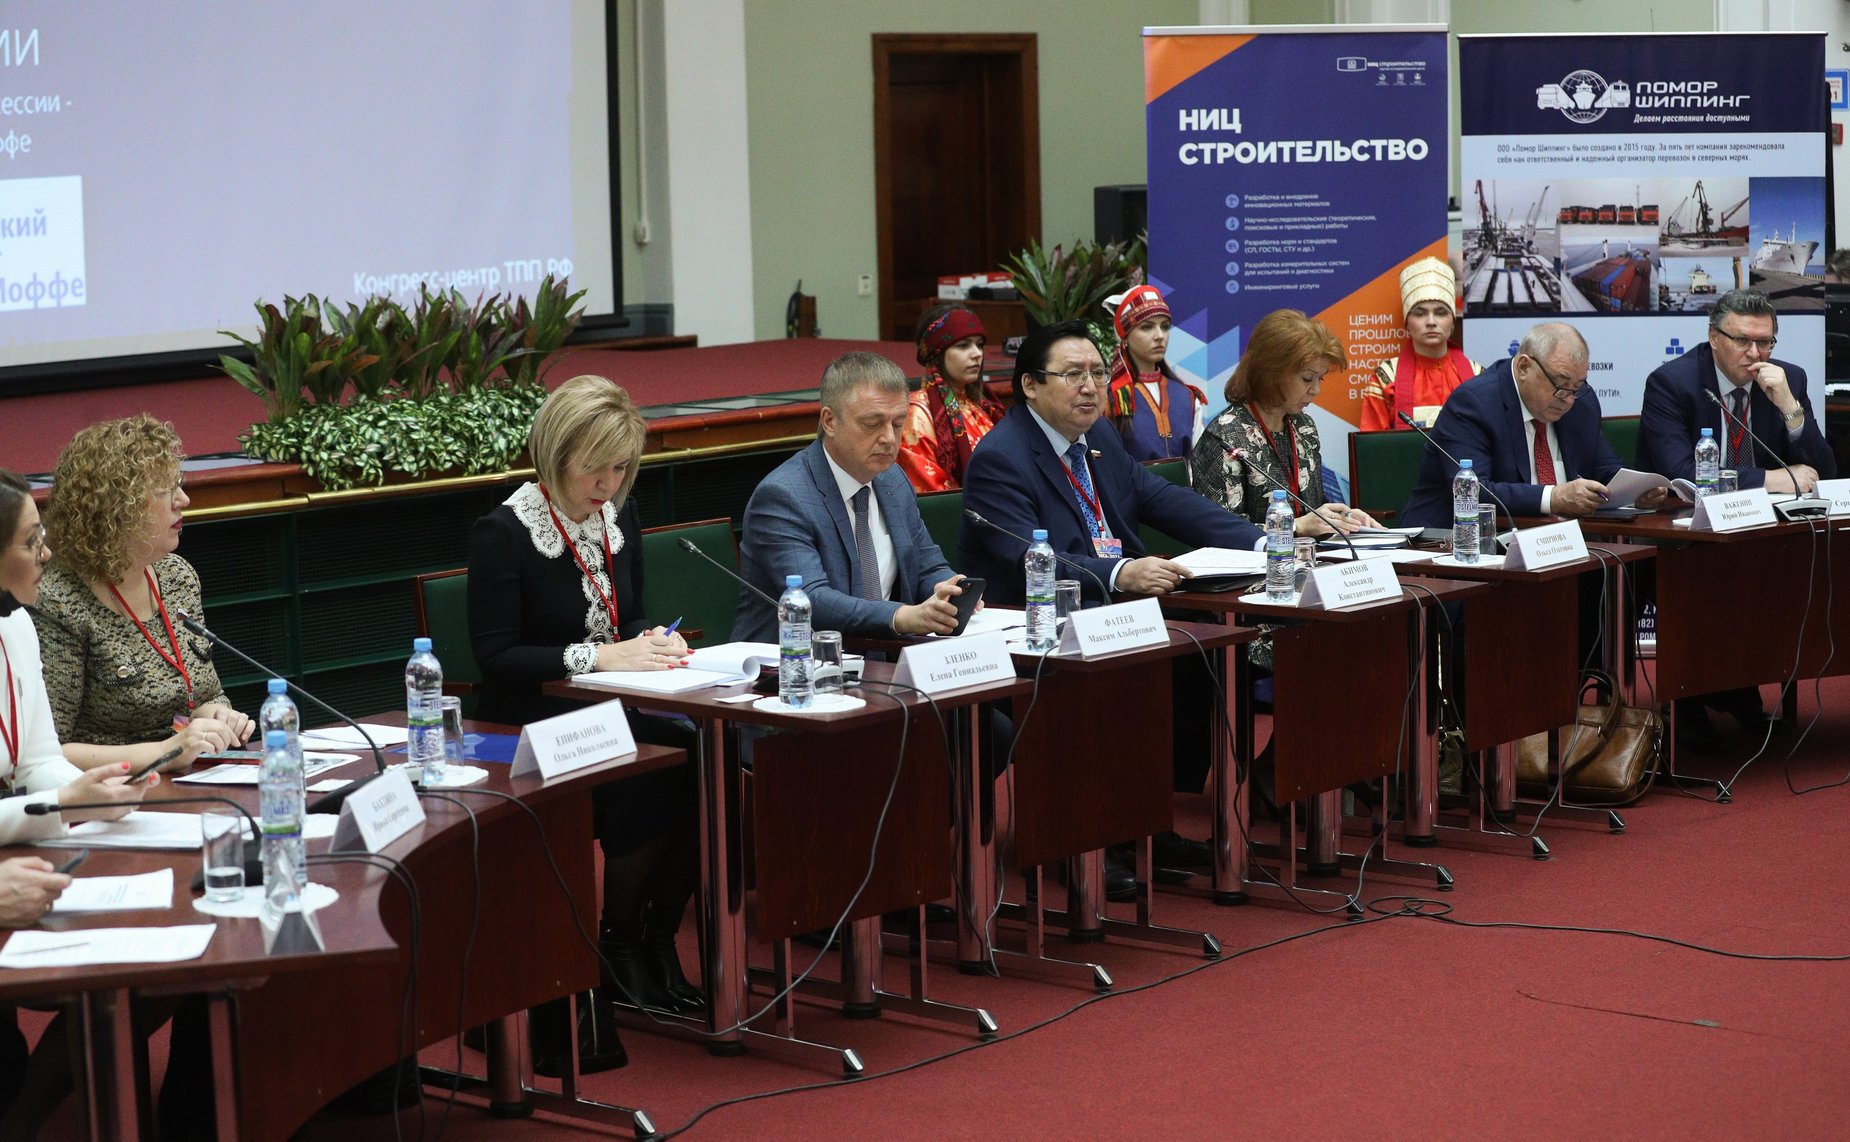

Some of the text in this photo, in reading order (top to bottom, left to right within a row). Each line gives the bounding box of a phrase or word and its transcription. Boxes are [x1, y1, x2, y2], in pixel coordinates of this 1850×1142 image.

[1636, 81, 1718, 94] ПОМОР
[0, 95, 60, 115] ессии
[1635, 95, 1751, 108] ШИППИНГ
[1179, 109, 1242, 134] НИЦ
[1633, 113, 1750, 124] Делаем расстояния доступными
[1178, 138, 1429, 165] СТРОИТЕЛЬСТВО
[1572, 143, 1589, 151] было
[1590, 144, 1617, 153] создано
[1624, 143, 1639, 151] 2015
[1729, 142, 1785, 151] зарекомендовала
[1657, 155, 1691, 163] перевозок
[1697, 154, 1728, 162] северных
[1349, 314, 1393, 327] ЦЕНИМ
[1349, 343, 1401, 355] СТРОИМ
[1349, 373, 1371, 385] СМ
[1340, 563, 1369, 576] АКИМОВ
[1343, 576, 1374, 588] Александр
[1338, 586, 1386, 601] Константинович
[1104, 614, 1135, 627] ФАТЕЕВ
[1088, 625, 1157, 643] Максим Альбертович
[944, 650, 978, 665] ЗЛЕНКО
[929, 672, 953, 682] Елена
[555, 724, 607, 746] ЕПИФАНОВА
[553, 750, 577, 763] Ольга
